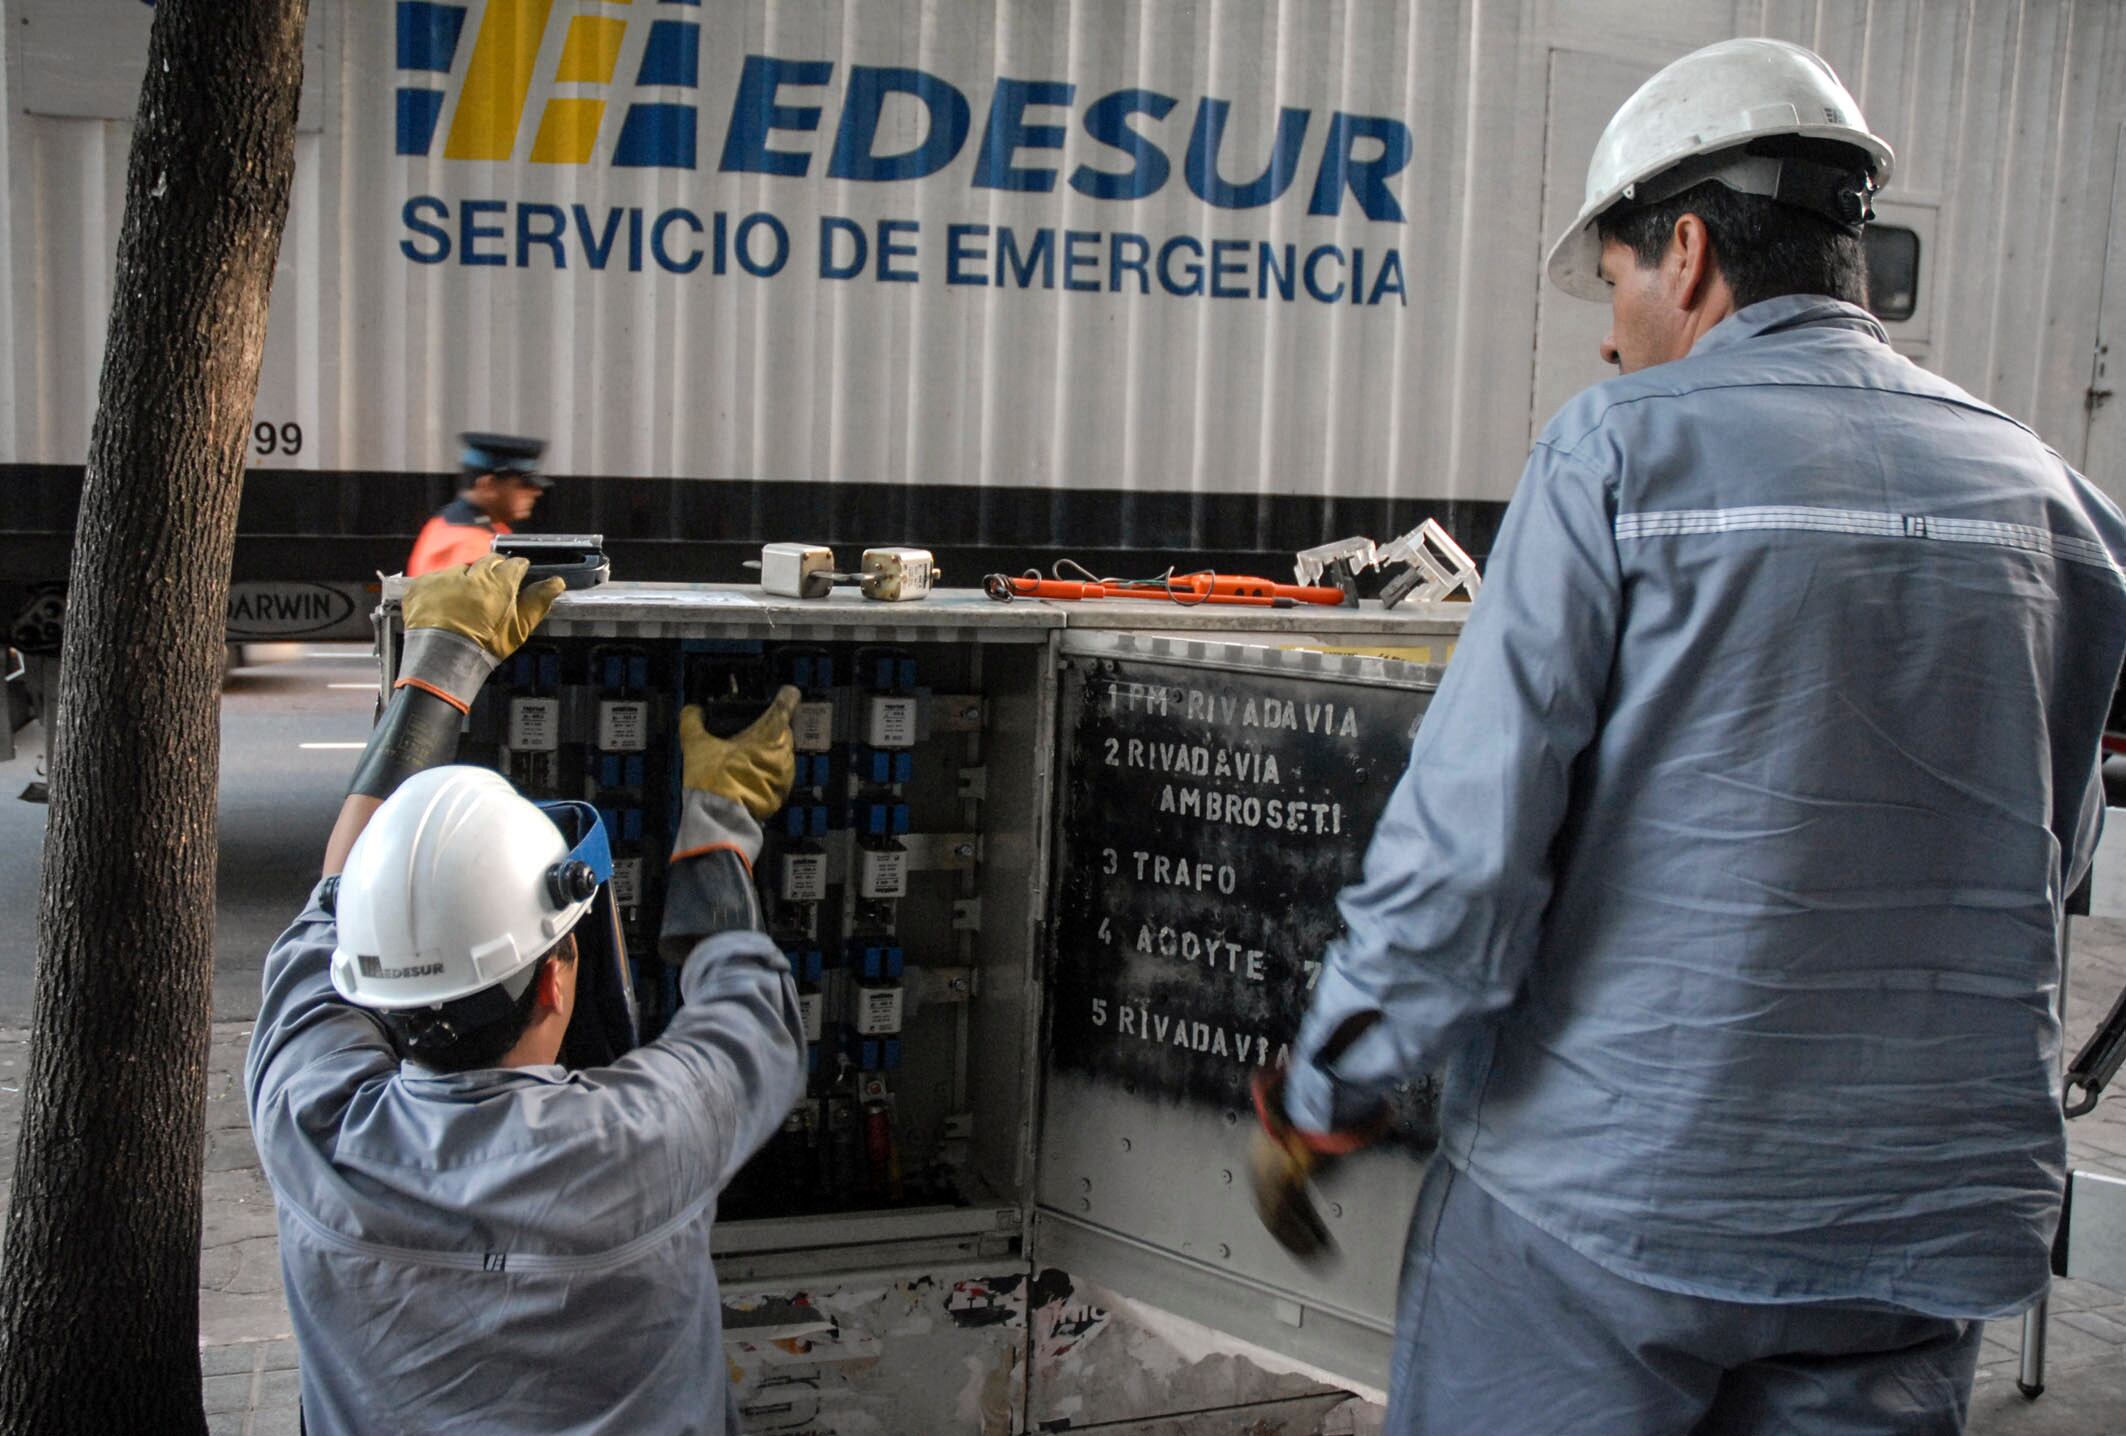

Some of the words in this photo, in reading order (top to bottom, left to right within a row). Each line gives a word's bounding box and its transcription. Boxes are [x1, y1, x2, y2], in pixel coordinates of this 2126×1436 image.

[719, 55, 1414, 224] EDESUR
[398, 195, 791, 279] SERVICIO
[818, 216, 920, 283] DE
[946, 222, 1408, 307] EMERGENCIA
[254, 421, 303, 456] 99
[1187, 689, 1358, 738] RIVADAVIA
[1104, 737, 1120, 767] 2
[1128, 738, 1280, 785] RIVADAVIA
[1160, 784, 1341, 835] AMBROSETI
[1102, 848, 1118, 875] 3
[1133, 851, 1236, 895] TRAFO
[1098, 917, 1112, 945] 4
[1092, 998, 1108, 1026] 5
[1119, 1005, 1291, 1071] RIVADAVIA
